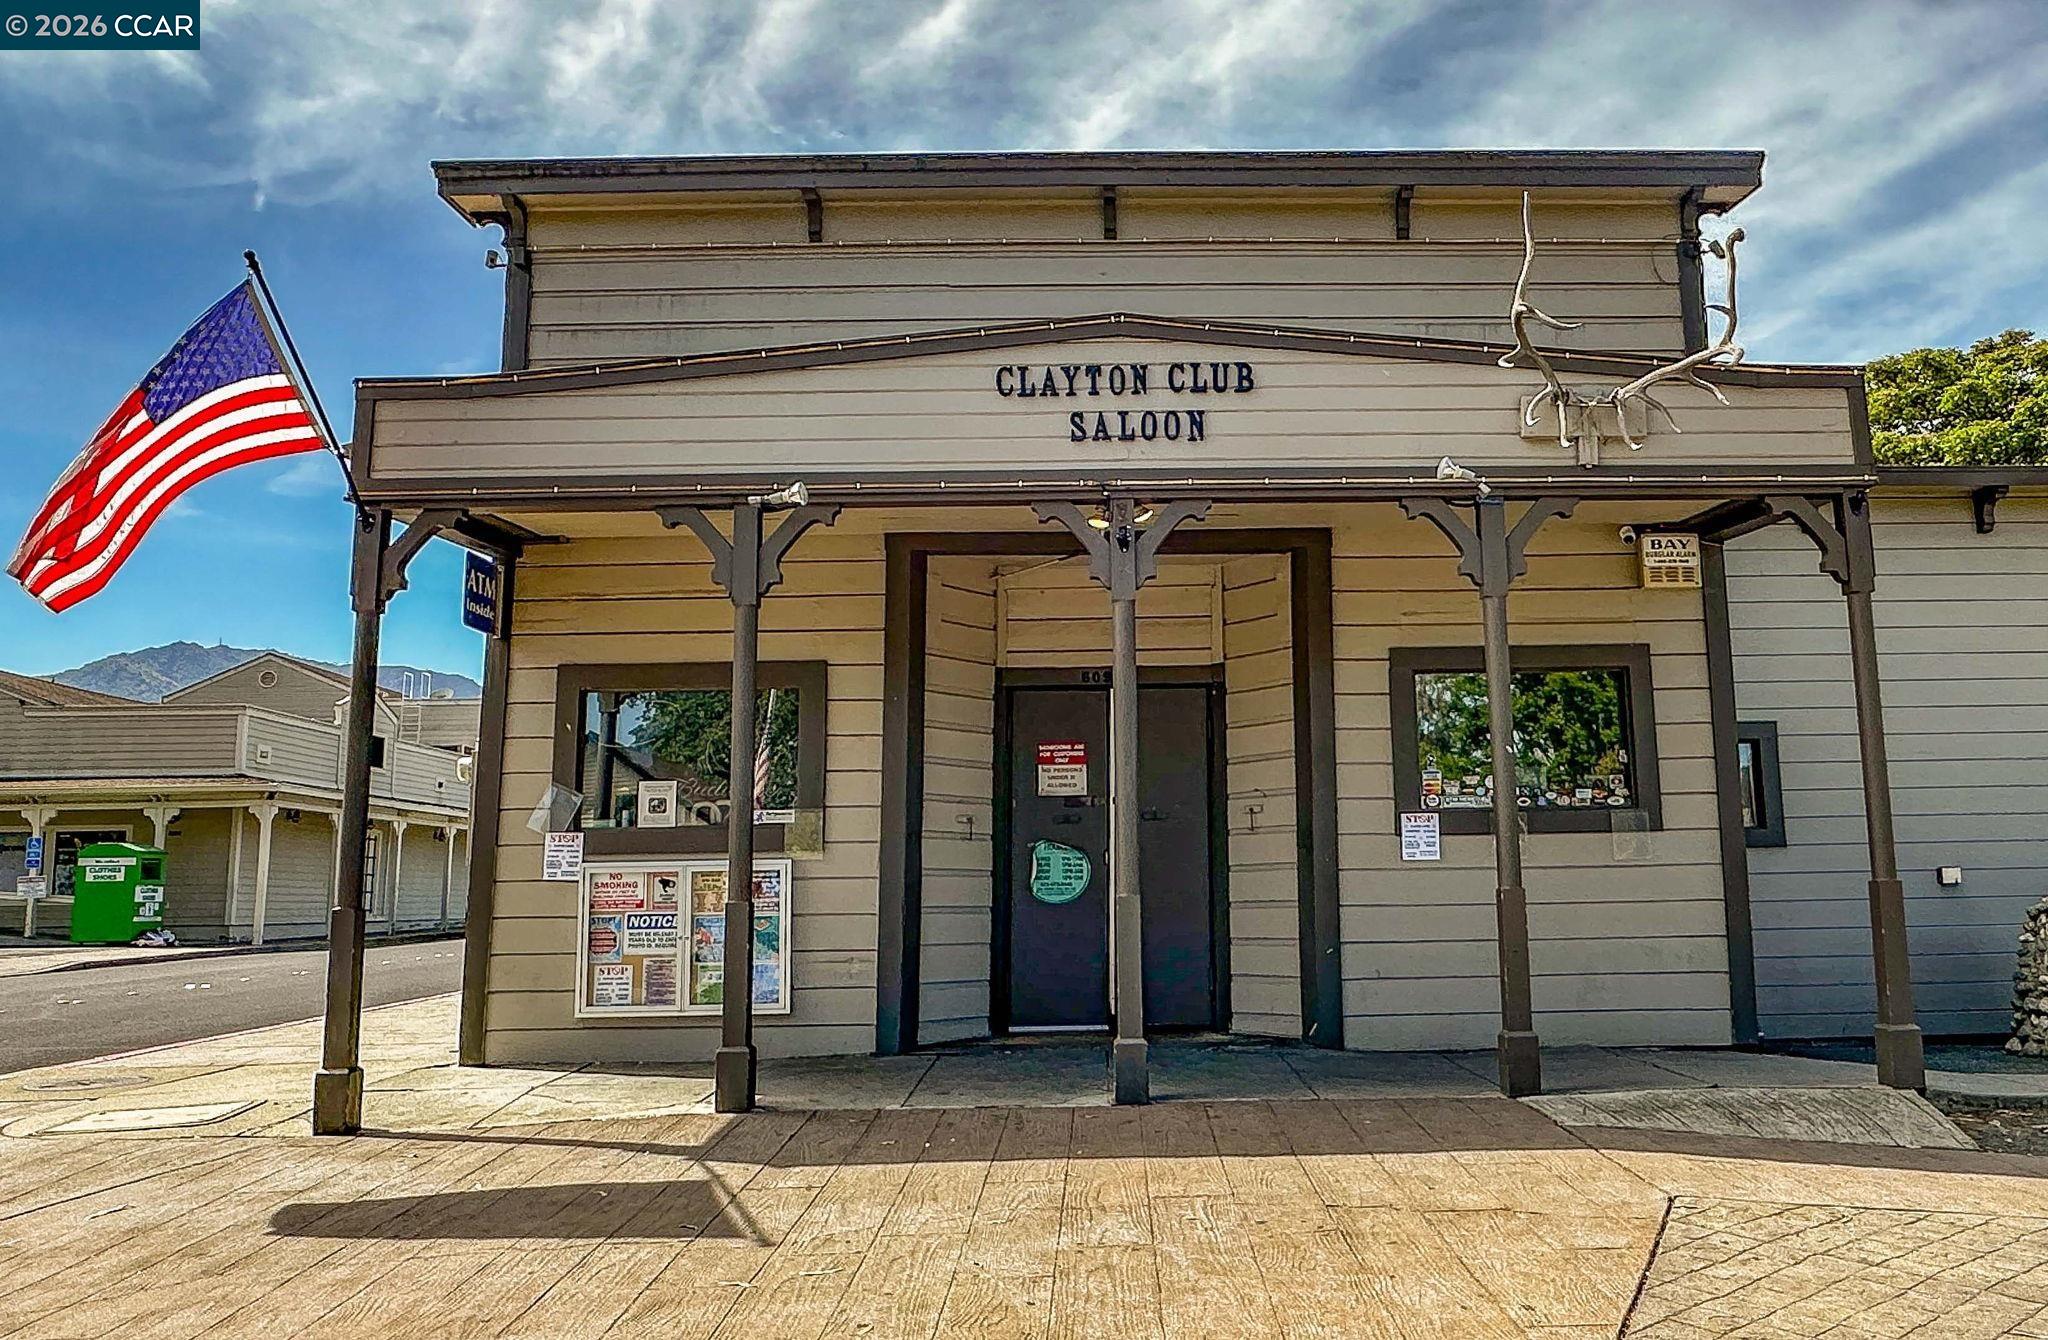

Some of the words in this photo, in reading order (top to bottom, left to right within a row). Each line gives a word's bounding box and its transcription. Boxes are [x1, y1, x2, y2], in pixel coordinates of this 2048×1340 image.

[995, 364, 1149, 397] CLAYTON
[1168, 362, 1255, 393] CLUB
[1070, 410, 1206, 442] SALOON
[1650, 538, 1691, 549] BAY
[467, 569, 496, 600] ATM
[466, 597, 495, 620] Inside
[1405, 814, 1434, 823] STOP
[550, 834, 579, 843] STOP
[609, 872, 622, 880] NO
[593, 881, 639, 889] SMOKING
[598, 966, 628, 975] STOP
